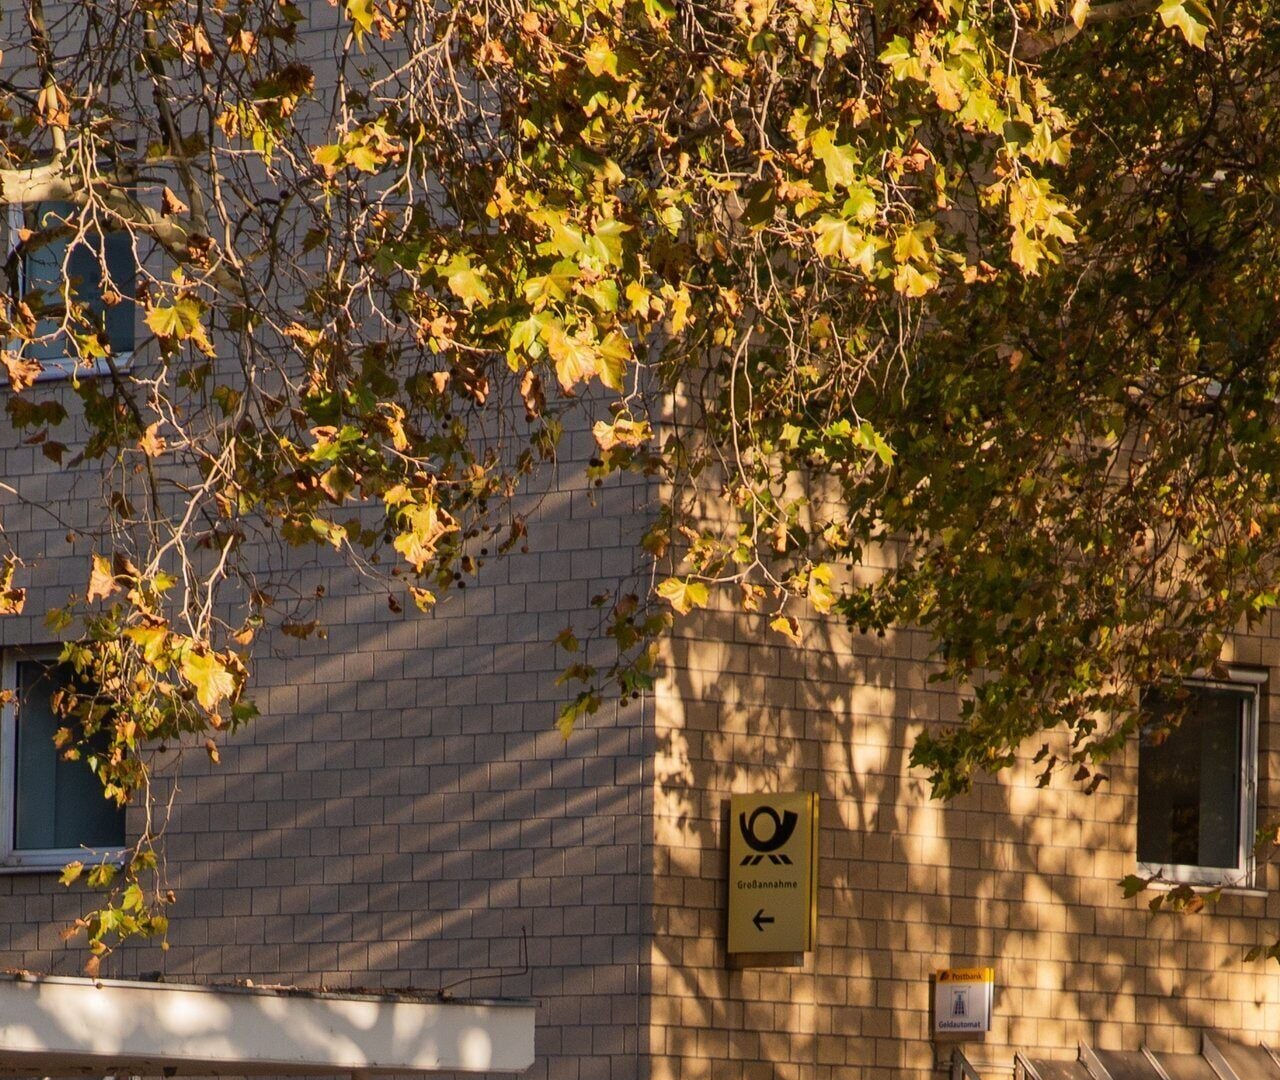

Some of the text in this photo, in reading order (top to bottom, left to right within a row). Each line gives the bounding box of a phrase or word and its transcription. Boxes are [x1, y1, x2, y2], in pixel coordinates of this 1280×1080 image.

[737, 879, 798, 889] Großannahme
[952, 971, 982, 980] Postbank
[938, 1020, 981, 1029] Geldautomat
